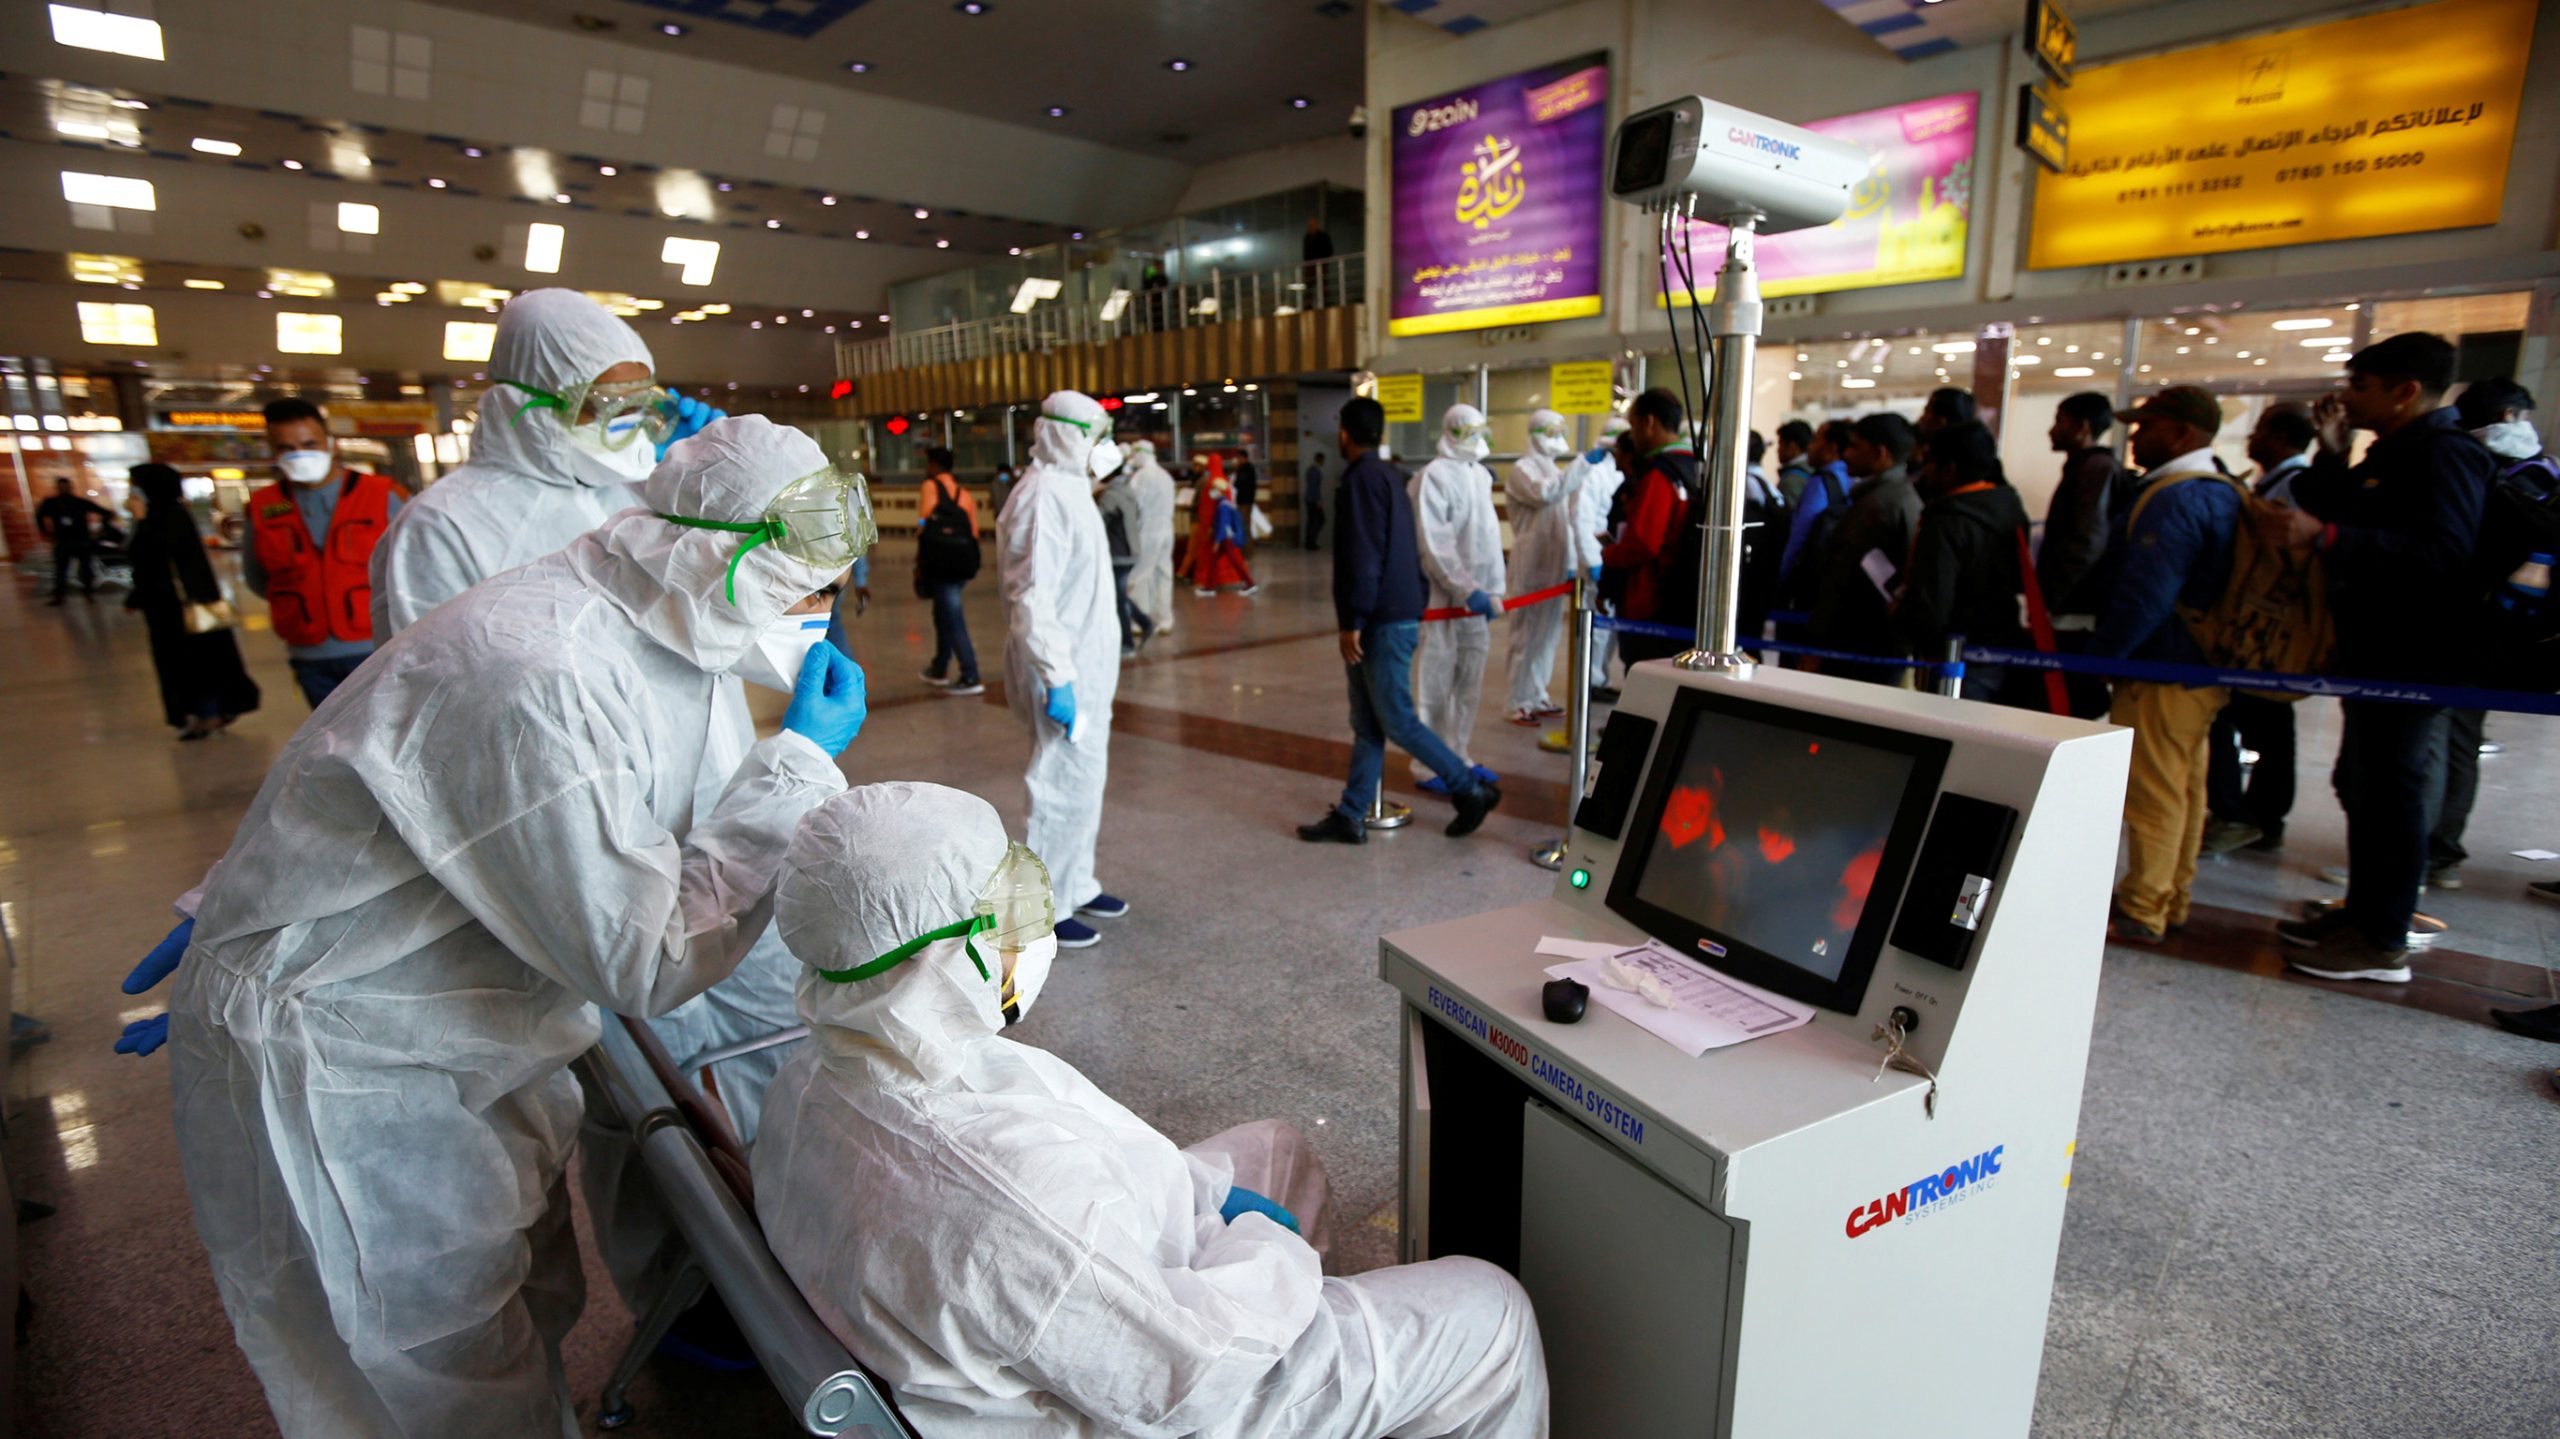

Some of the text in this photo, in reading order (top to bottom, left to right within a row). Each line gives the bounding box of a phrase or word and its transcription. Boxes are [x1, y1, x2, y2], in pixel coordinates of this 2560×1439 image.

[1728, 127, 1800, 160] CANTRONIC
[2372, 151, 2425, 171] 5000
[1428, 986, 1644, 1145] FEVERSCAN M3000D CAMERA SYSTEM
[1846, 1144, 2004, 1239] CANTRONIC
[1905, 1177, 2000, 1226] SYSTEMS INC.
